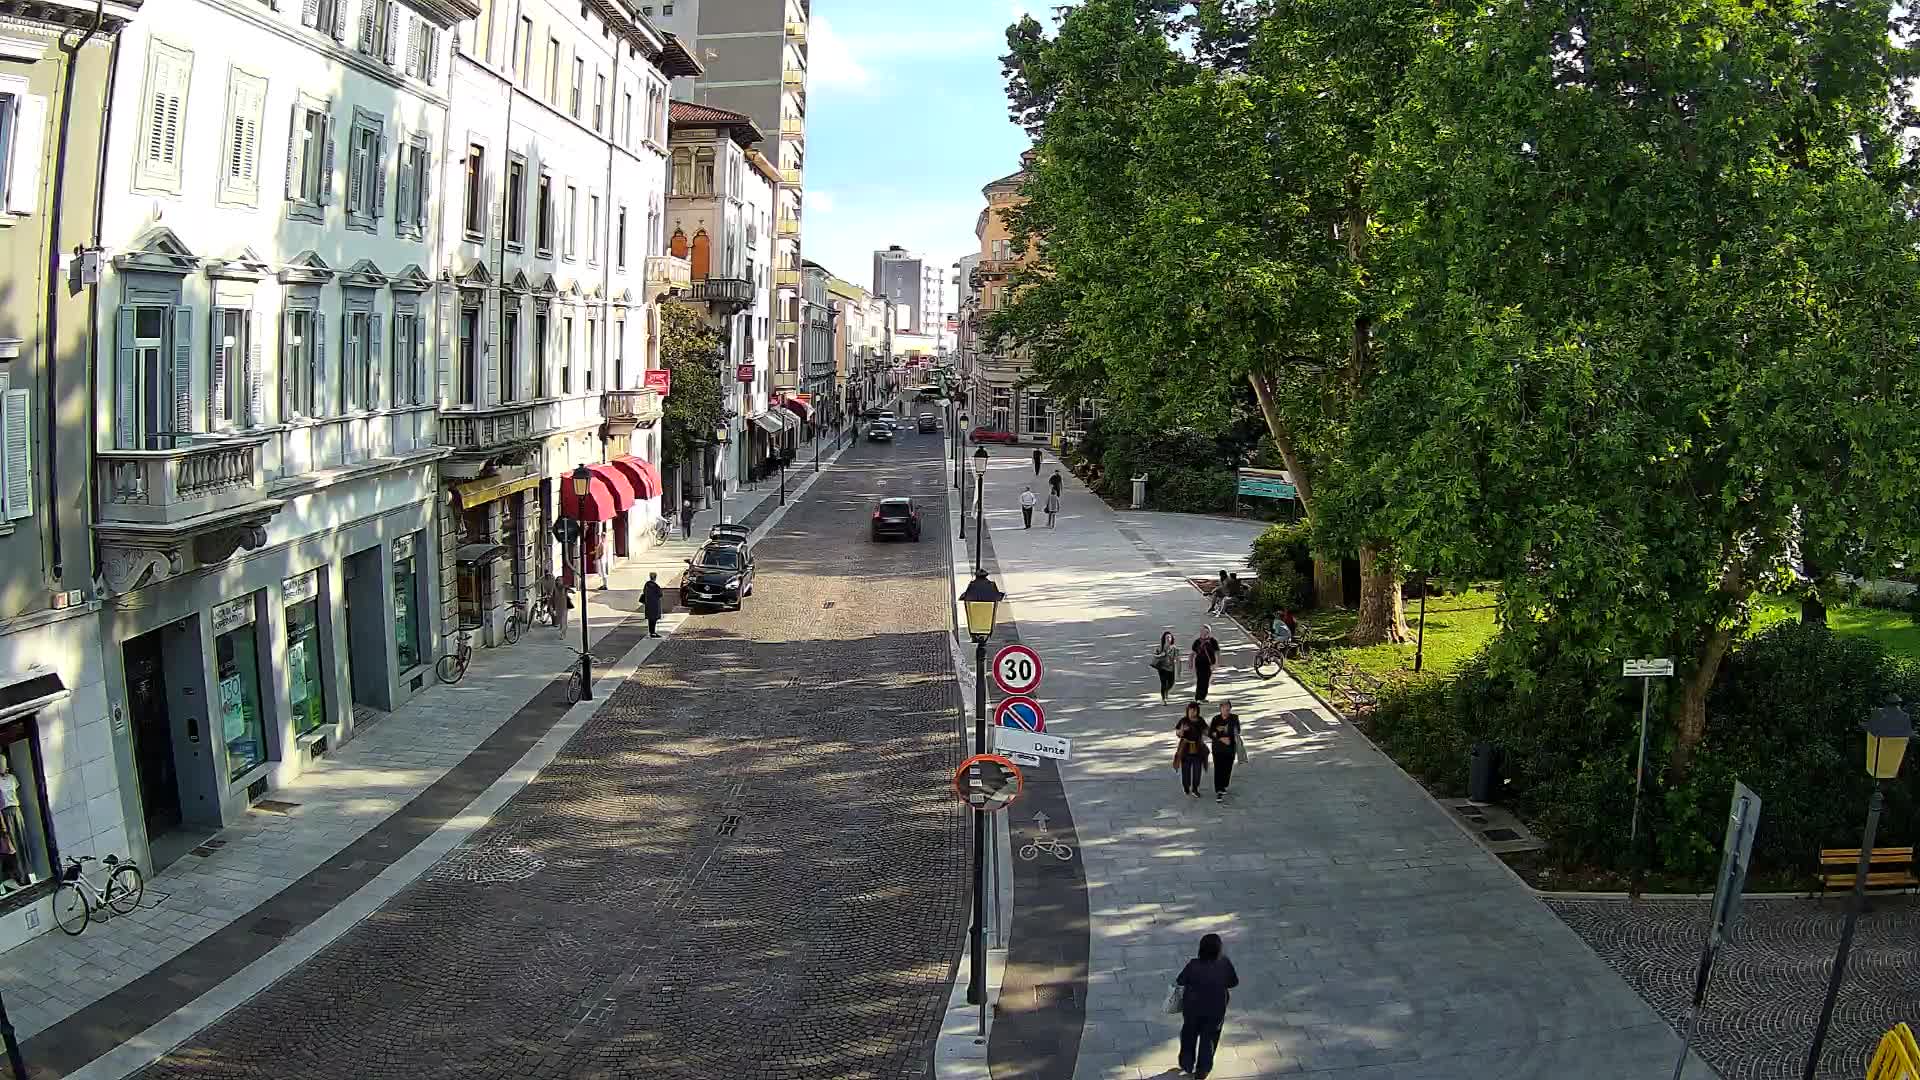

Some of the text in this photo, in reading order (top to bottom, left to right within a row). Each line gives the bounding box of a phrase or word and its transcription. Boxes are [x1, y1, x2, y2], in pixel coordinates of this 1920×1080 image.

[1004, 659, 1032, 681] 30
[221, 678, 239, 702] 130
[1034, 742, 1065, 755] Dante
